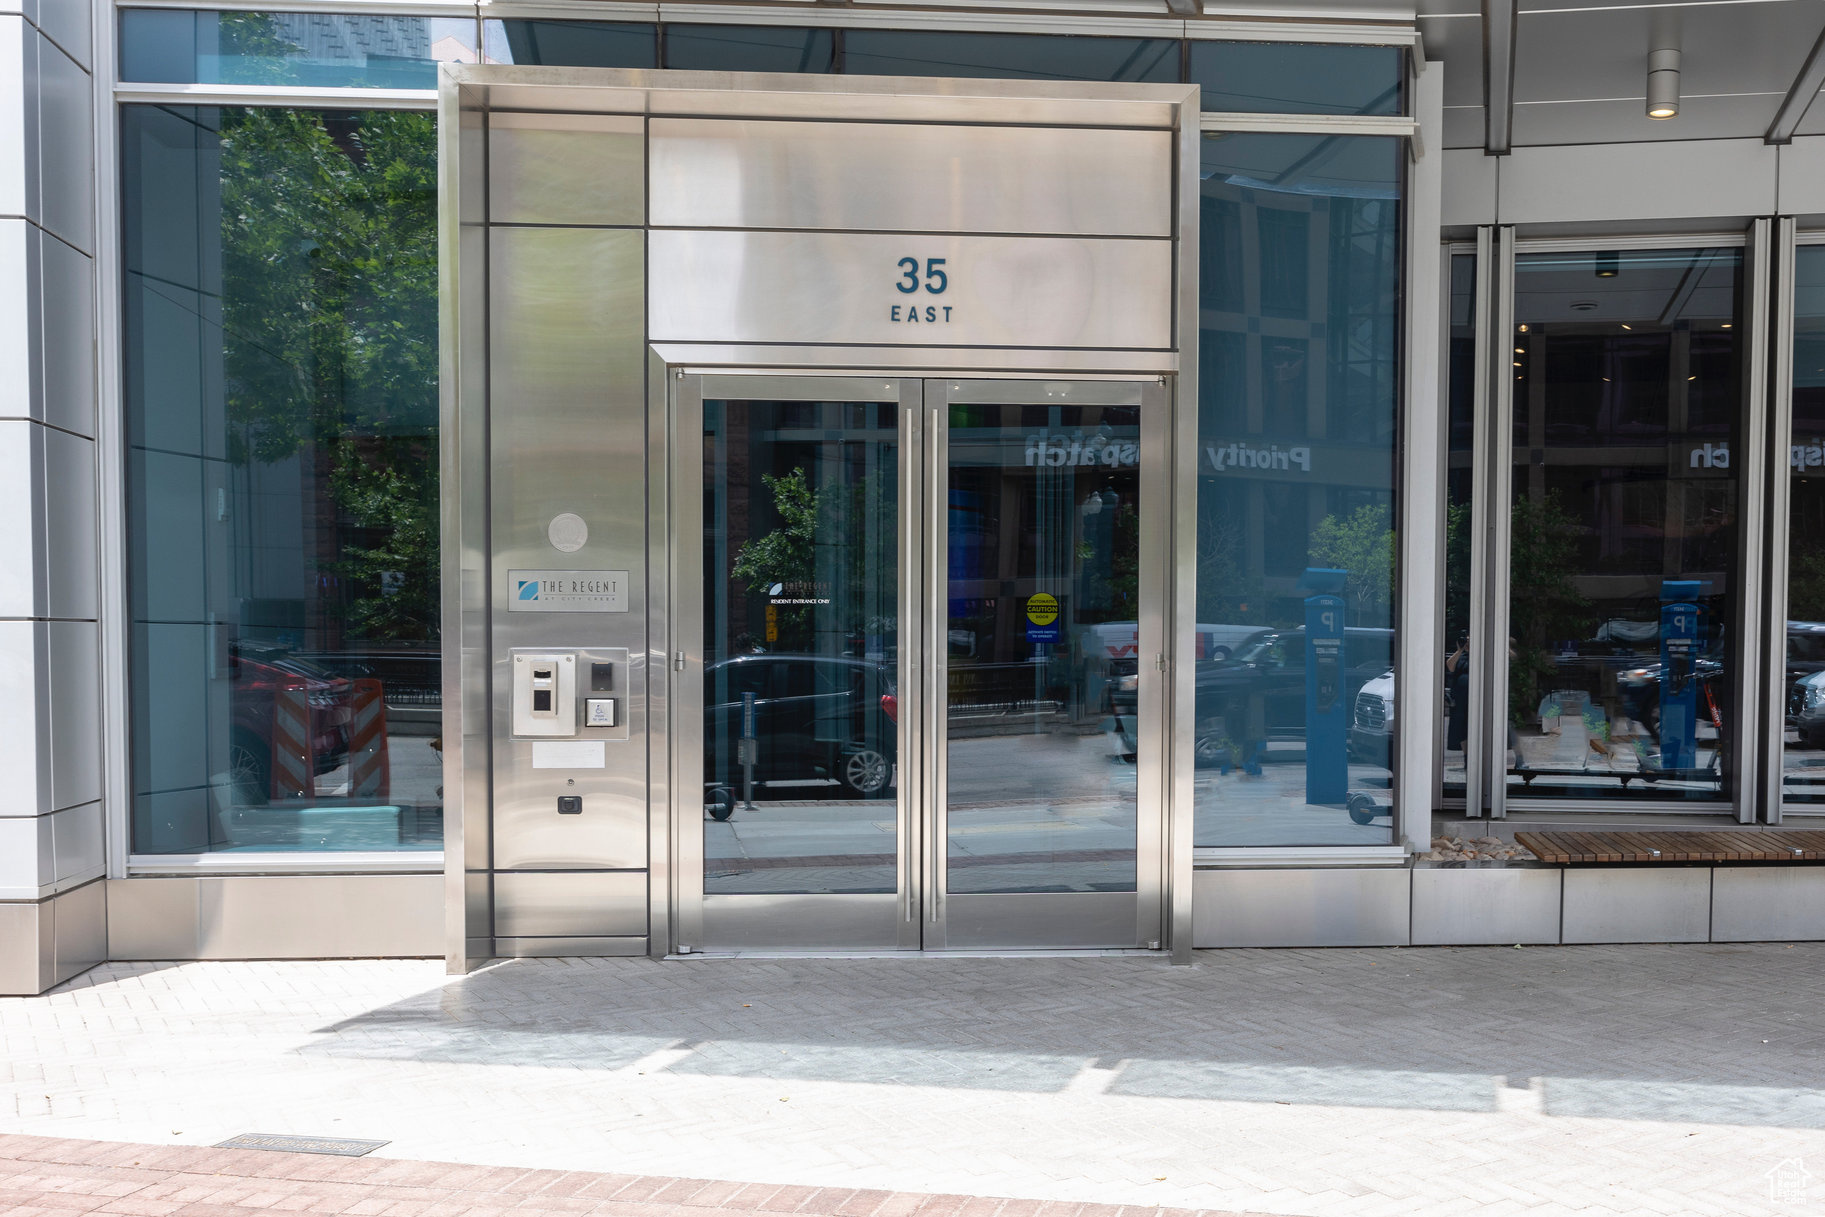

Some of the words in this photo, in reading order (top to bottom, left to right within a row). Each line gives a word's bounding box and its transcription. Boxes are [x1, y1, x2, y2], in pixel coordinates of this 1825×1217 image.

[896, 257, 948, 294] 35
[891, 305, 953, 323] EAST
[542, 580, 563, 593] THE
[572, 580, 617, 593] REGENT
